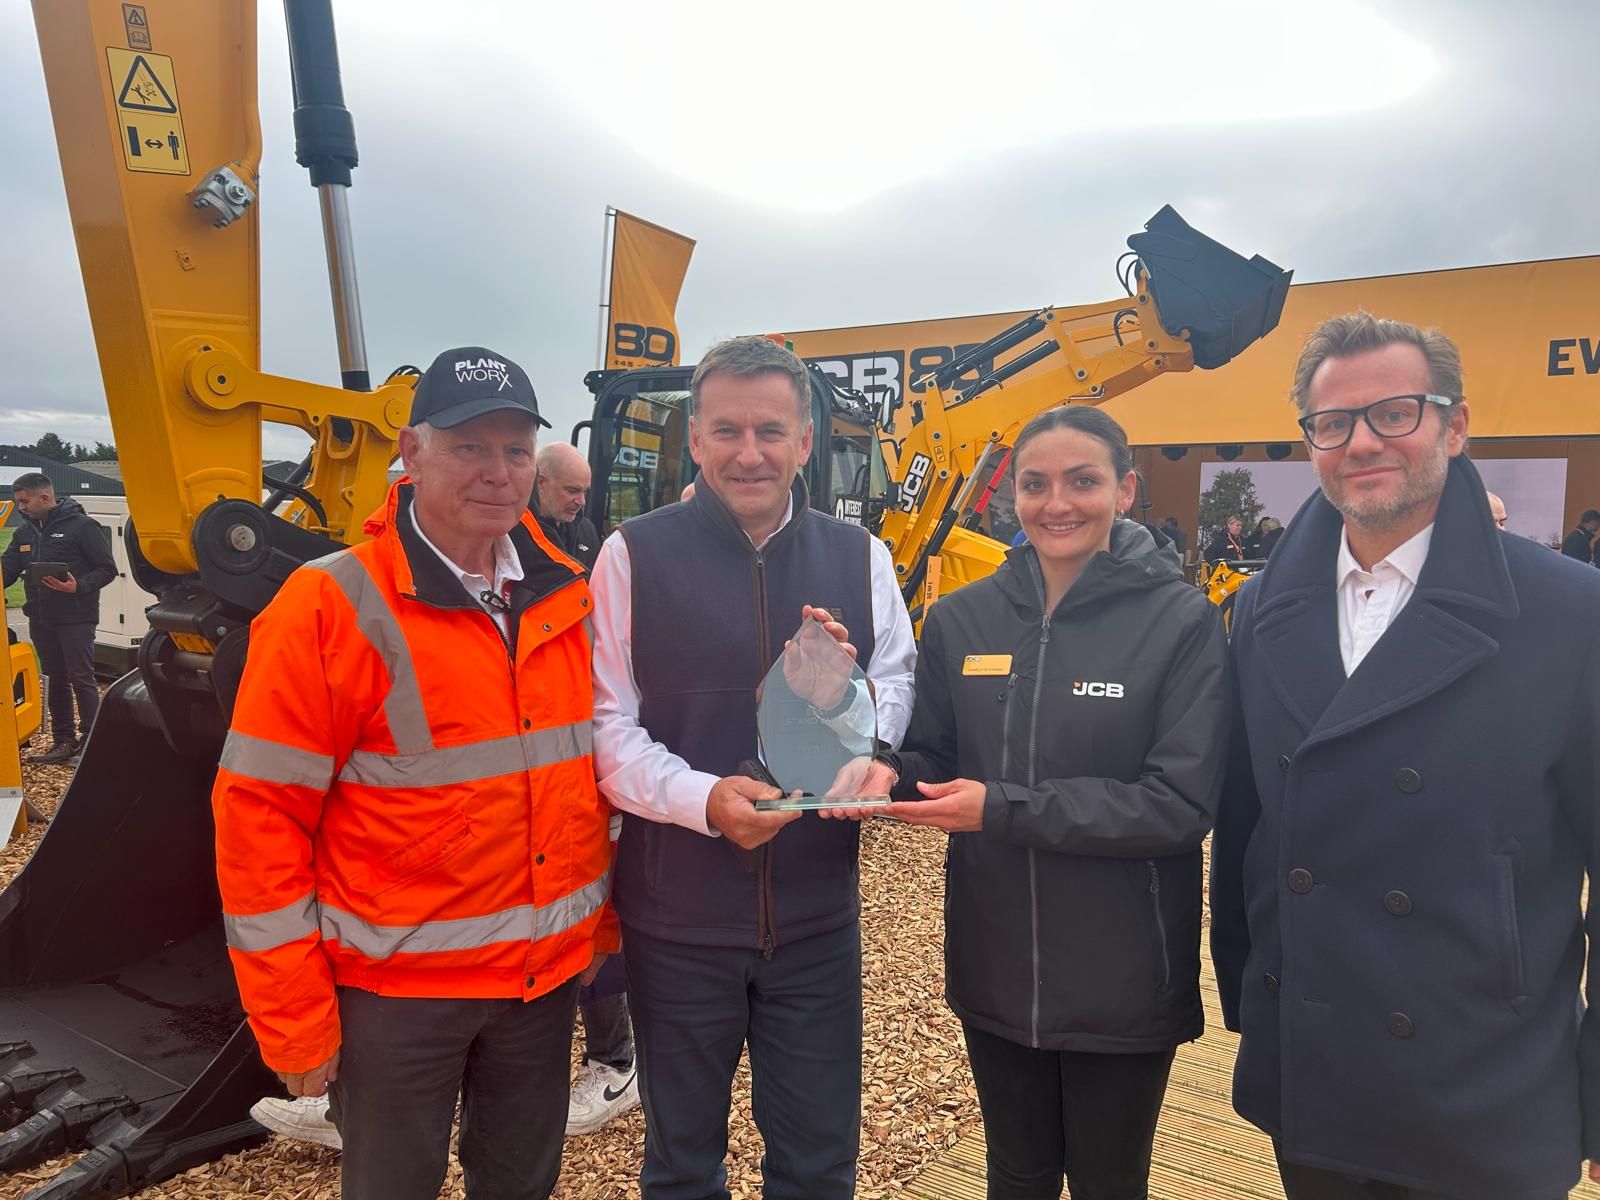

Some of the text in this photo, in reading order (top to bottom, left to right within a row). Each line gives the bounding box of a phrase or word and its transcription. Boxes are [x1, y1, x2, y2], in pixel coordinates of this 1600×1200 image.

[455, 358, 507, 372] PLANT
[456, 369, 513, 392] WORX
[902, 455, 931, 512] JCB
[1072, 681, 1125, 699] JCB
